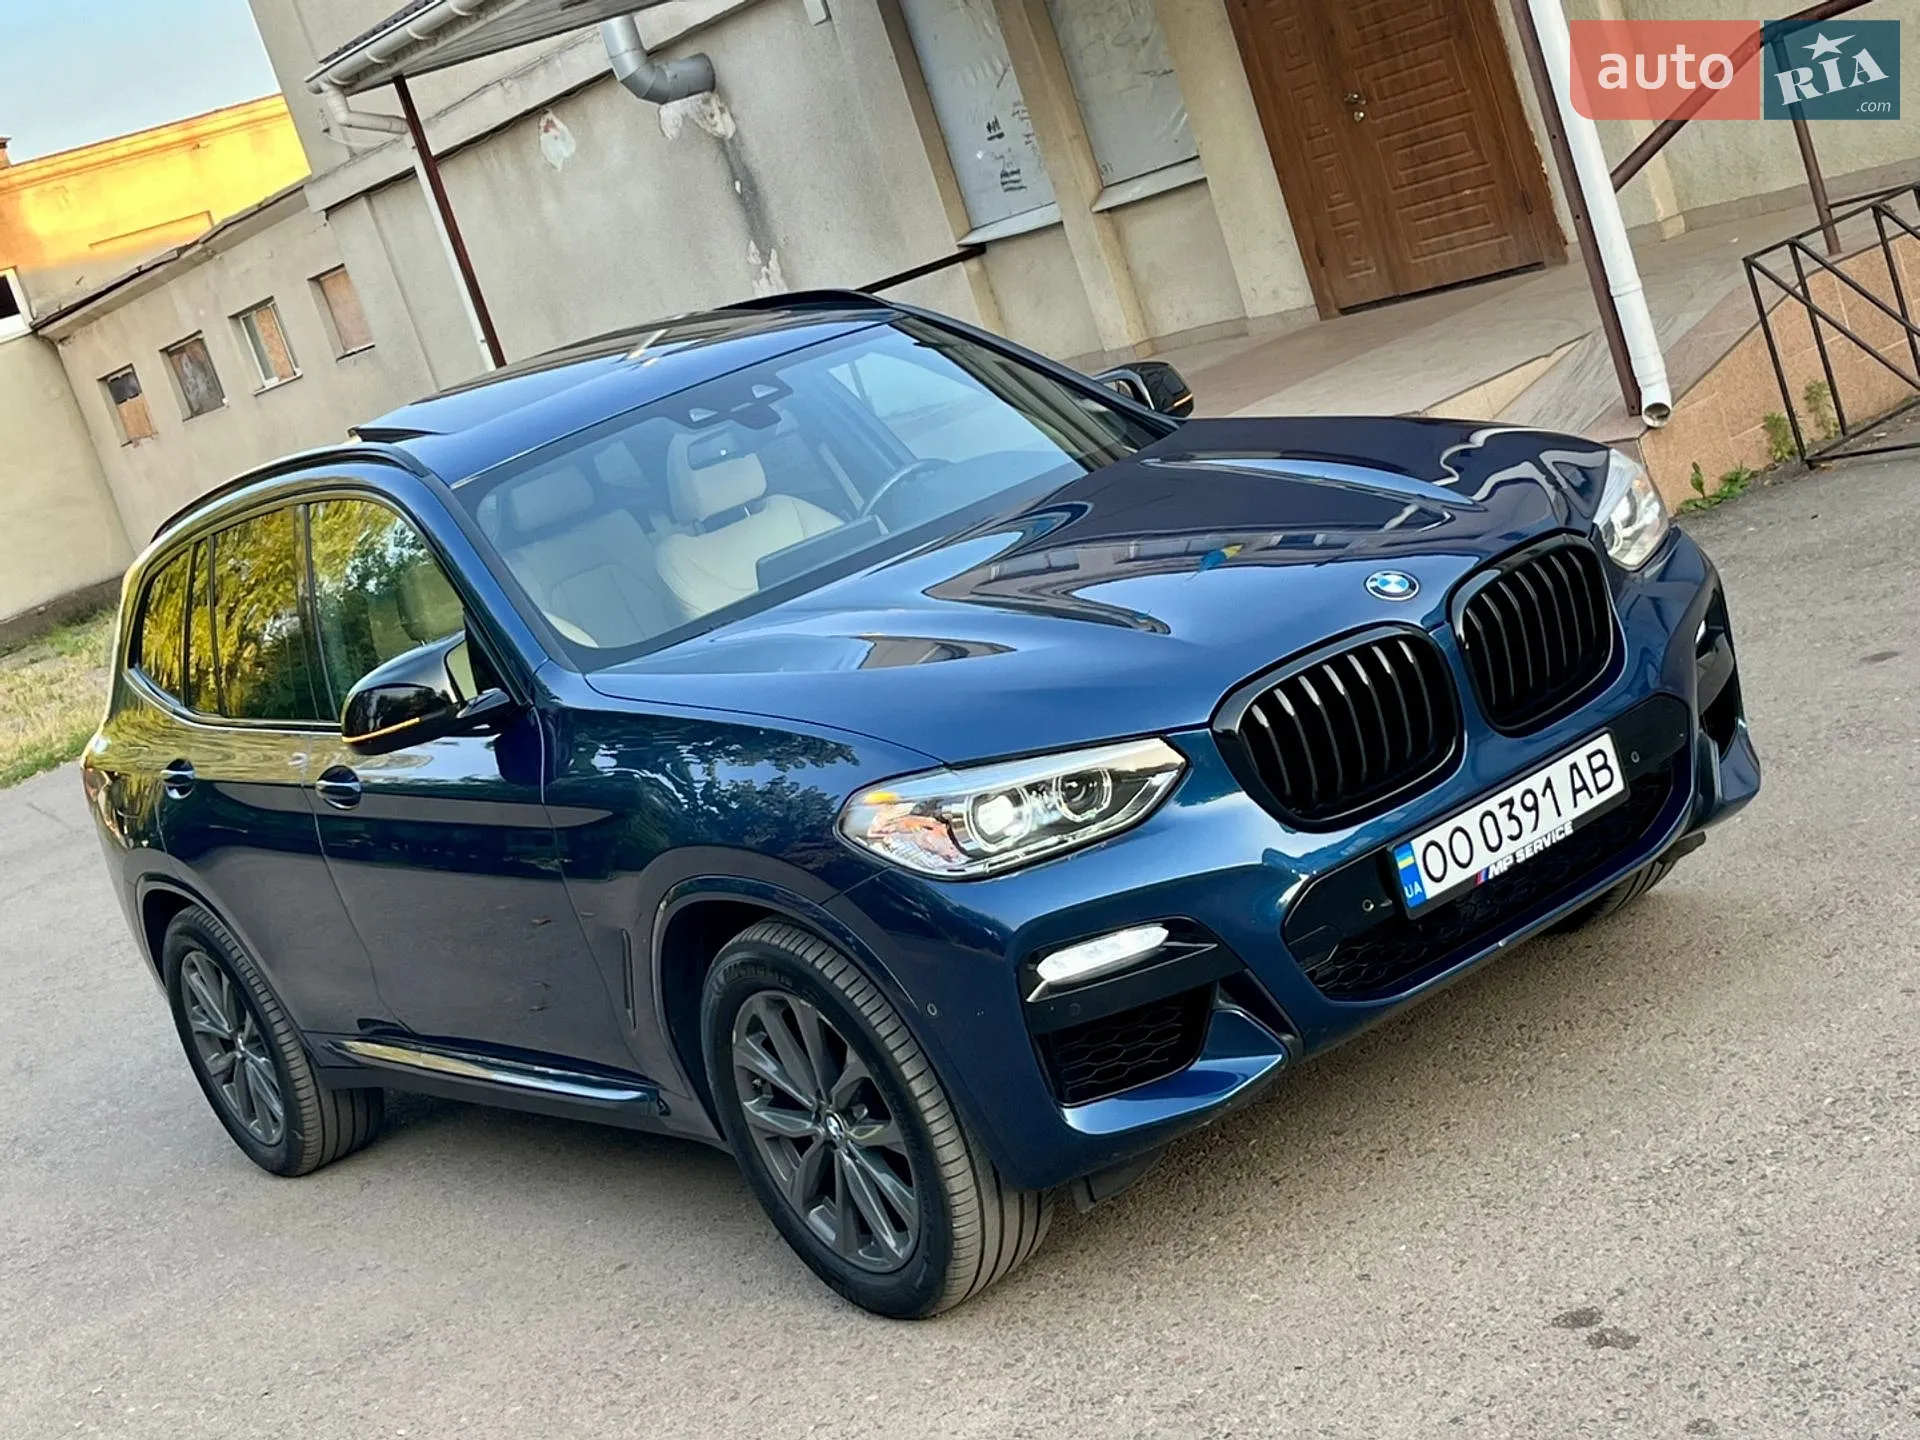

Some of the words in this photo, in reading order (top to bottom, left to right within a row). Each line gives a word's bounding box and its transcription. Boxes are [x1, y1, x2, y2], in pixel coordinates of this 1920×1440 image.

[1422, 825, 1474, 883] OO
[1479, 776, 1562, 853] 0391
[1568, 748, 1615, 808] AB
[1488, 856, 1514, 879] MP
[1515, 820, 1574, 864] SERVICE
[1404, 885, 1423, 899] UA
